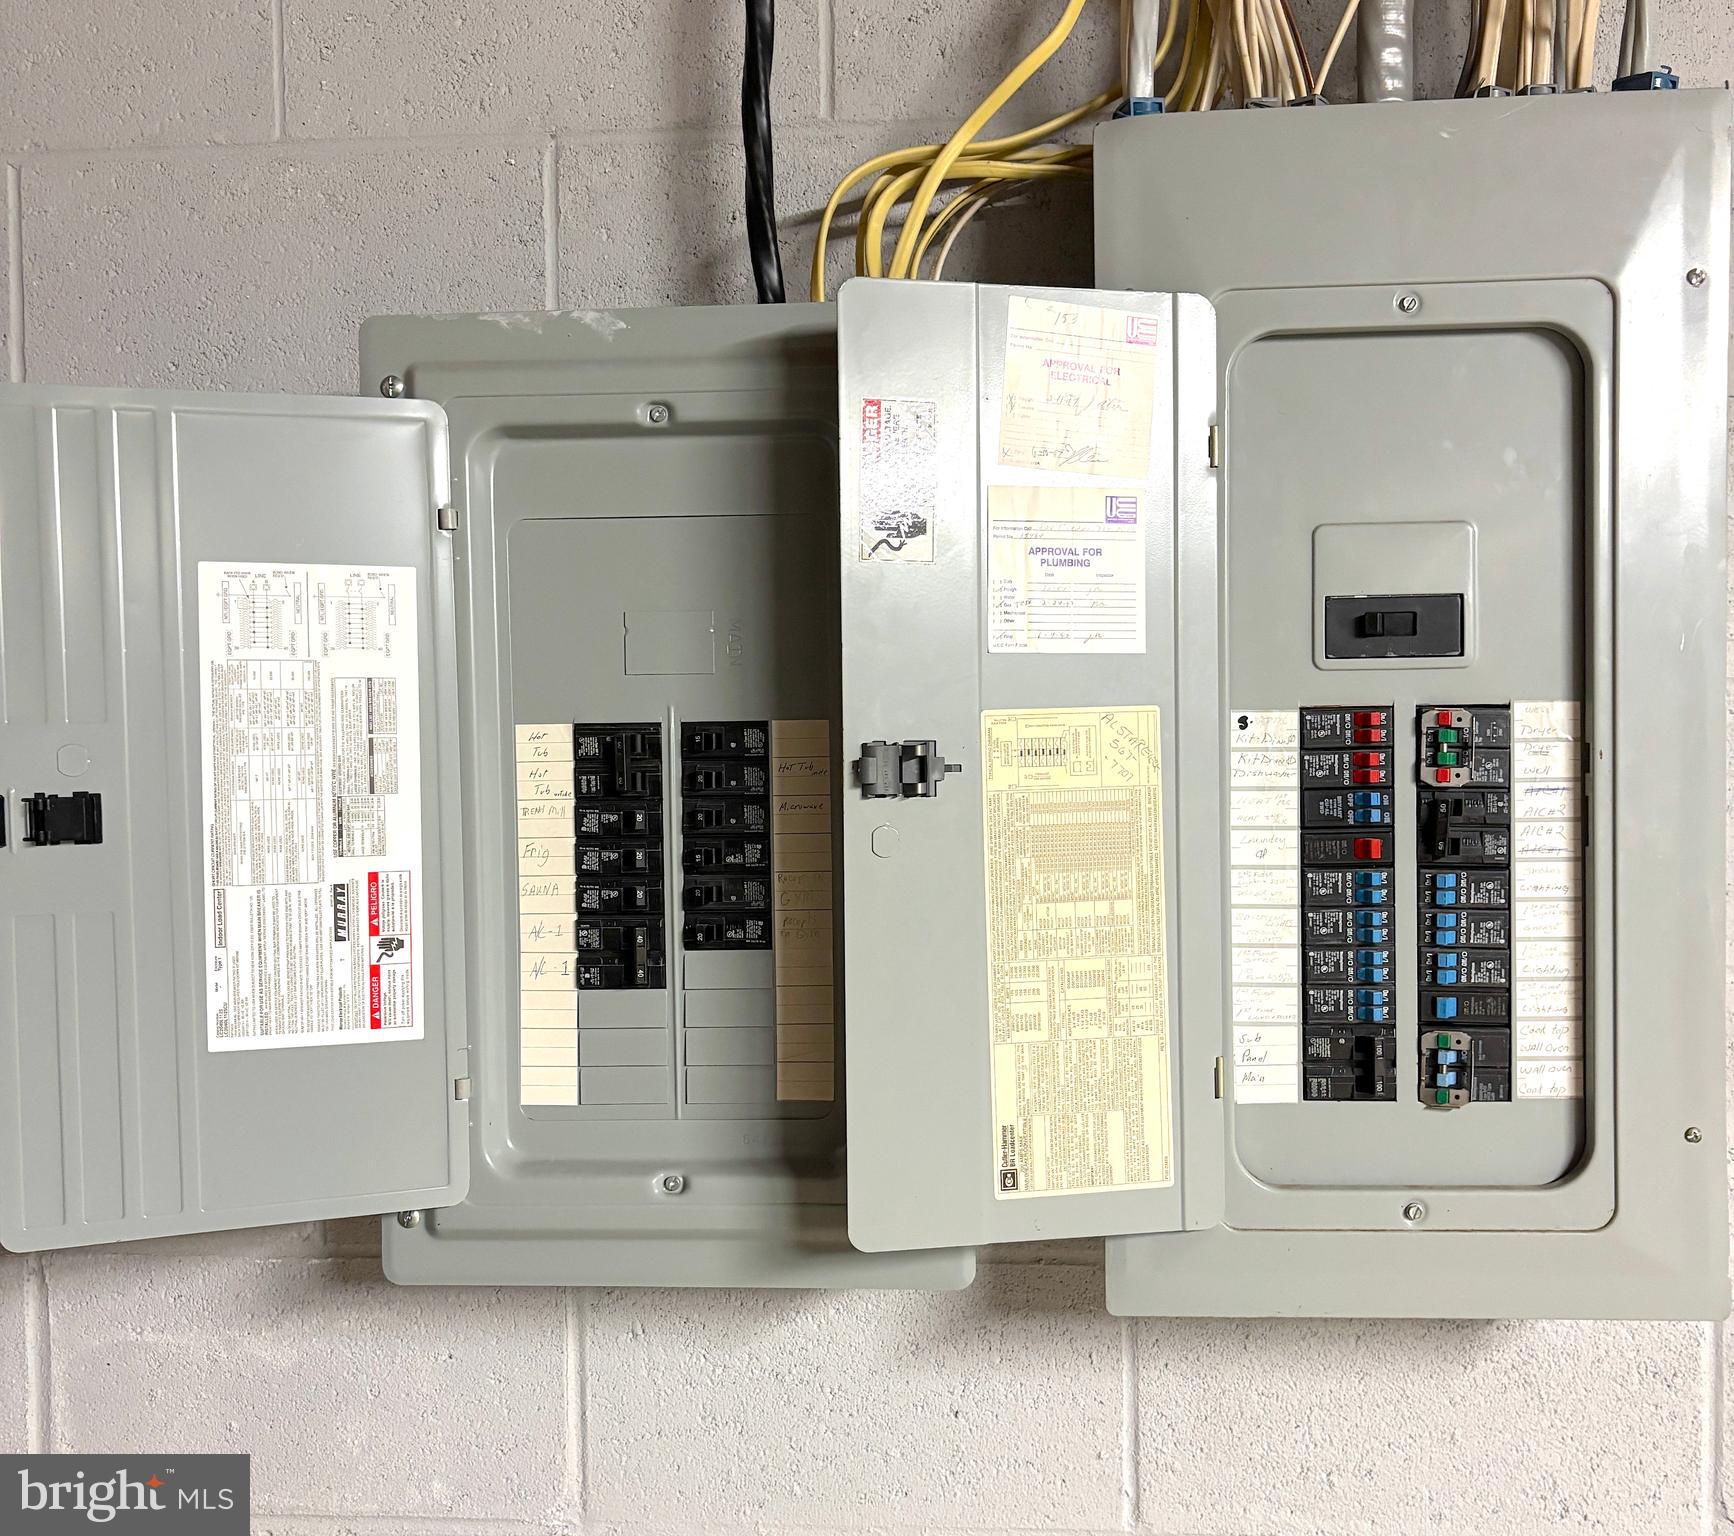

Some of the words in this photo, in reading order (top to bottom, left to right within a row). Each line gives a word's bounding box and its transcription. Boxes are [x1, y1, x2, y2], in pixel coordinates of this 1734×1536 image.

[1042, 359, 1095, 373] APPROVAL
[1051, 371, 1111, 386] ELECTRICAL
[1028, 547, 1079, 556] APPROVAL
[1083, 548, 1102, 556] FOR
[1040, 559, 1091, 567] PLUMBING
[1521, 725, 1557, 736] Dryer
[532, 747, 549, 757] Tub
[529, 769, 548, 778] Hot
[534, 785, 551, 795] Tub
[779, 803, 824, 812] Microwave
[636, 814, 643, 822] 20
[521, 882, 559, 897] SAUNA
[336, 887, 347, 937] MURRAY
[636, 935, 643, 943] 40
[697, 933, 703, 941] 20
[637, 969, 644, 978] 40
[1242, 1049, 1267, 1063] Panel
[1242, 1072, 1265, 1083] Main
[1550, 1082, 1566, 1096] top
